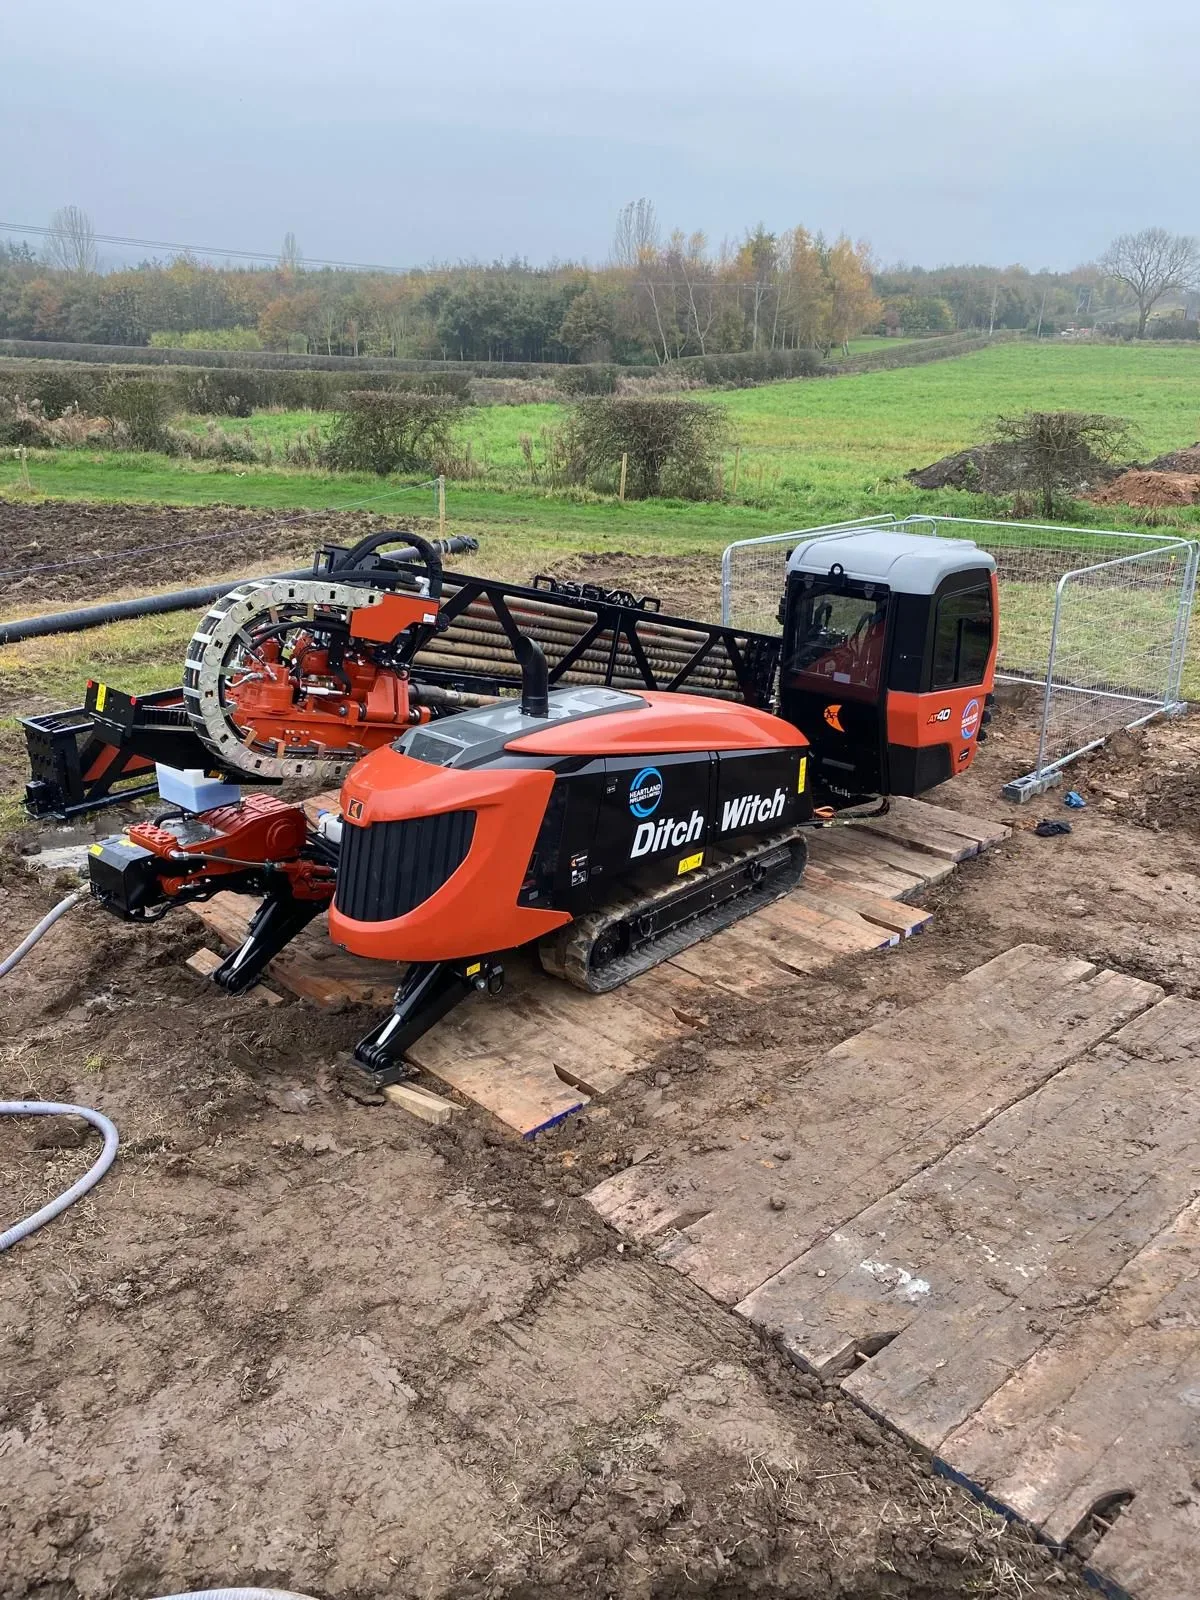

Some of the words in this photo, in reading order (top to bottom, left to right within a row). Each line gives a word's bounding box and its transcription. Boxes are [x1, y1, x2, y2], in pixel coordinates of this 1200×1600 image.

[927, 708, 951, 724] AT40
[629, 783, 661, 798] HEARTLAND
[630, 810, 704, 859] Ditch
[721, 788, 786, 831] Witch
